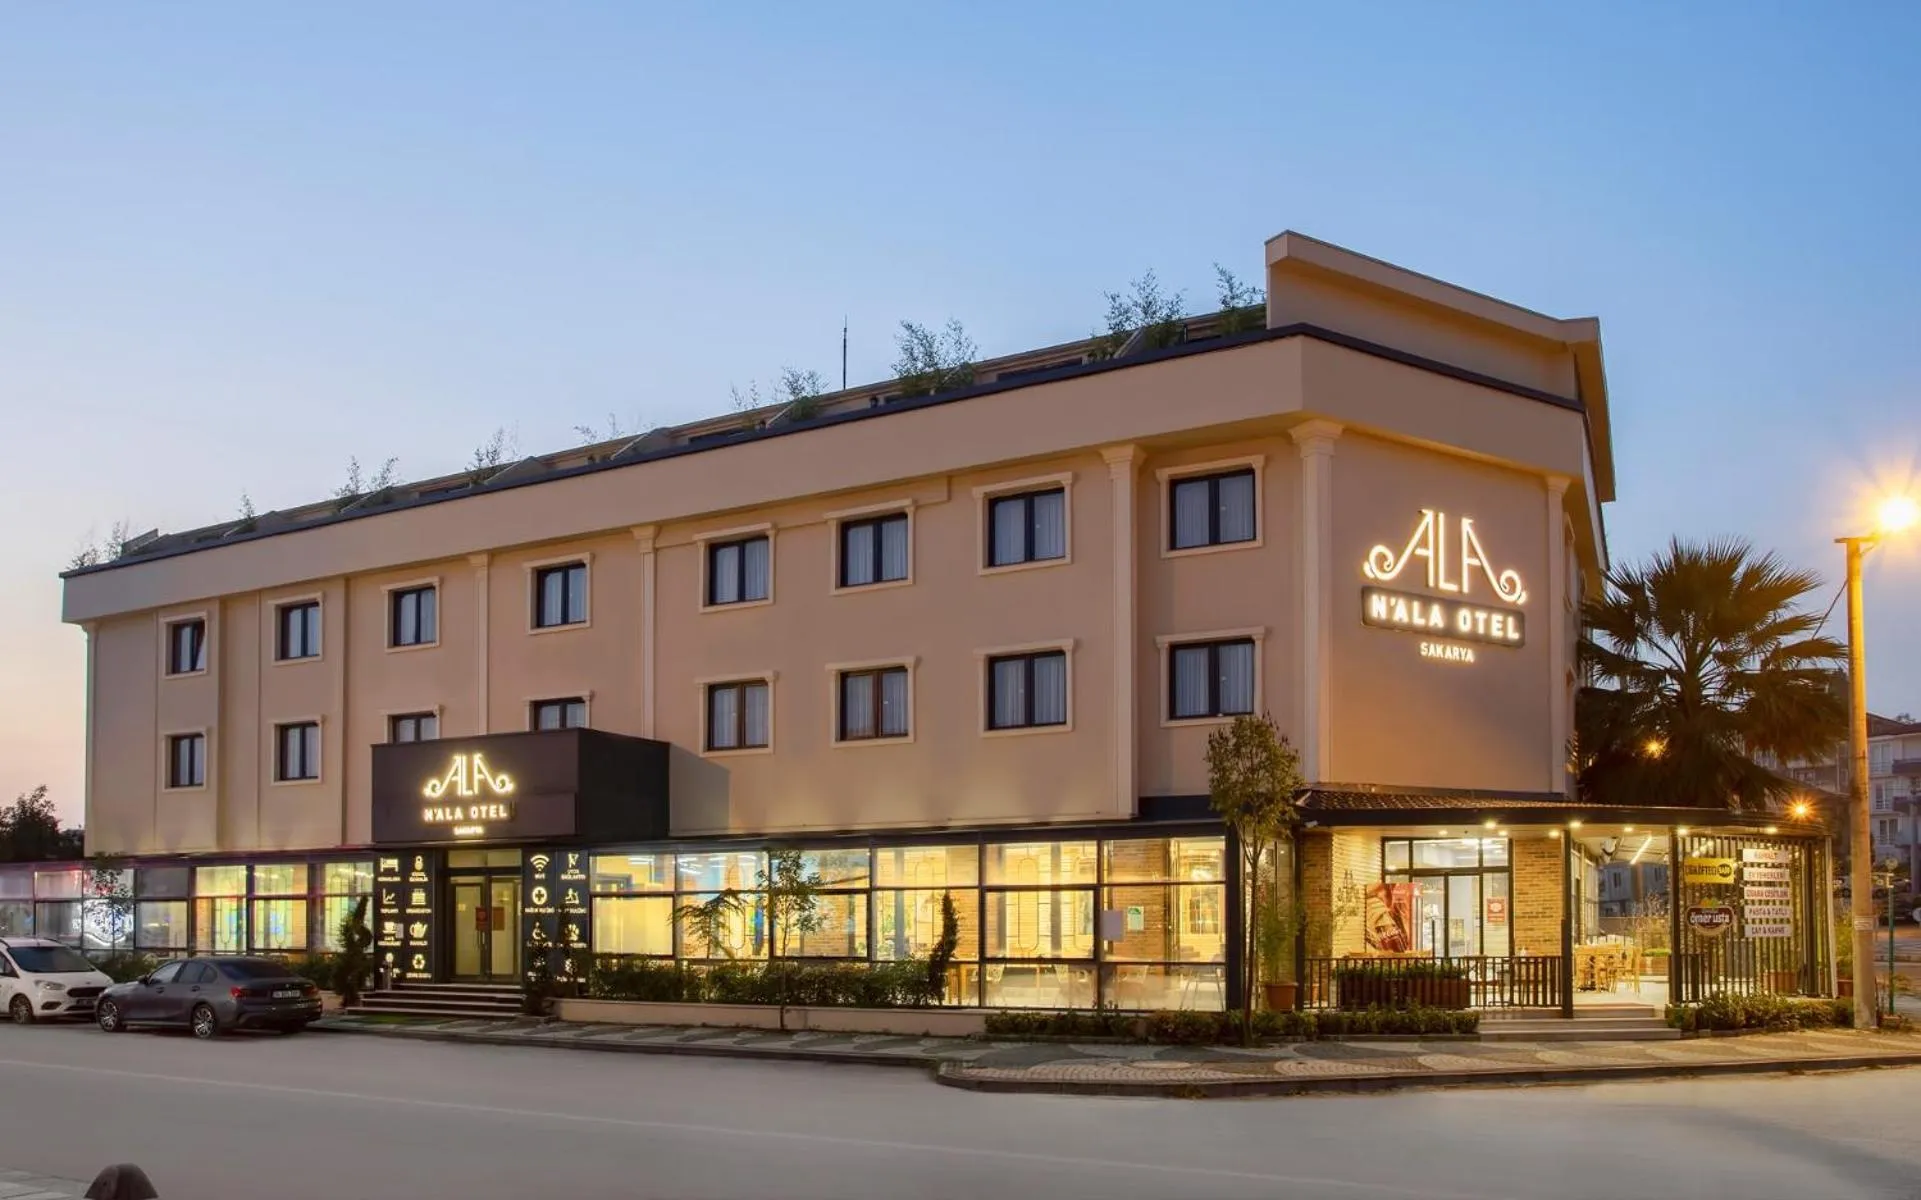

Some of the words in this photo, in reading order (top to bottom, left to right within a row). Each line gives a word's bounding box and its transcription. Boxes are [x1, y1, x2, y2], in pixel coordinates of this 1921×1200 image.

[1371, 594, 1444, 628] N'ALA
[1458, 608, 1520, 640] OTEL
[1420, 642, 1474, 662] SAKARYA
[423, 808, 463, 822] N'ALA
[471, 805, 507, 819] OTEL
